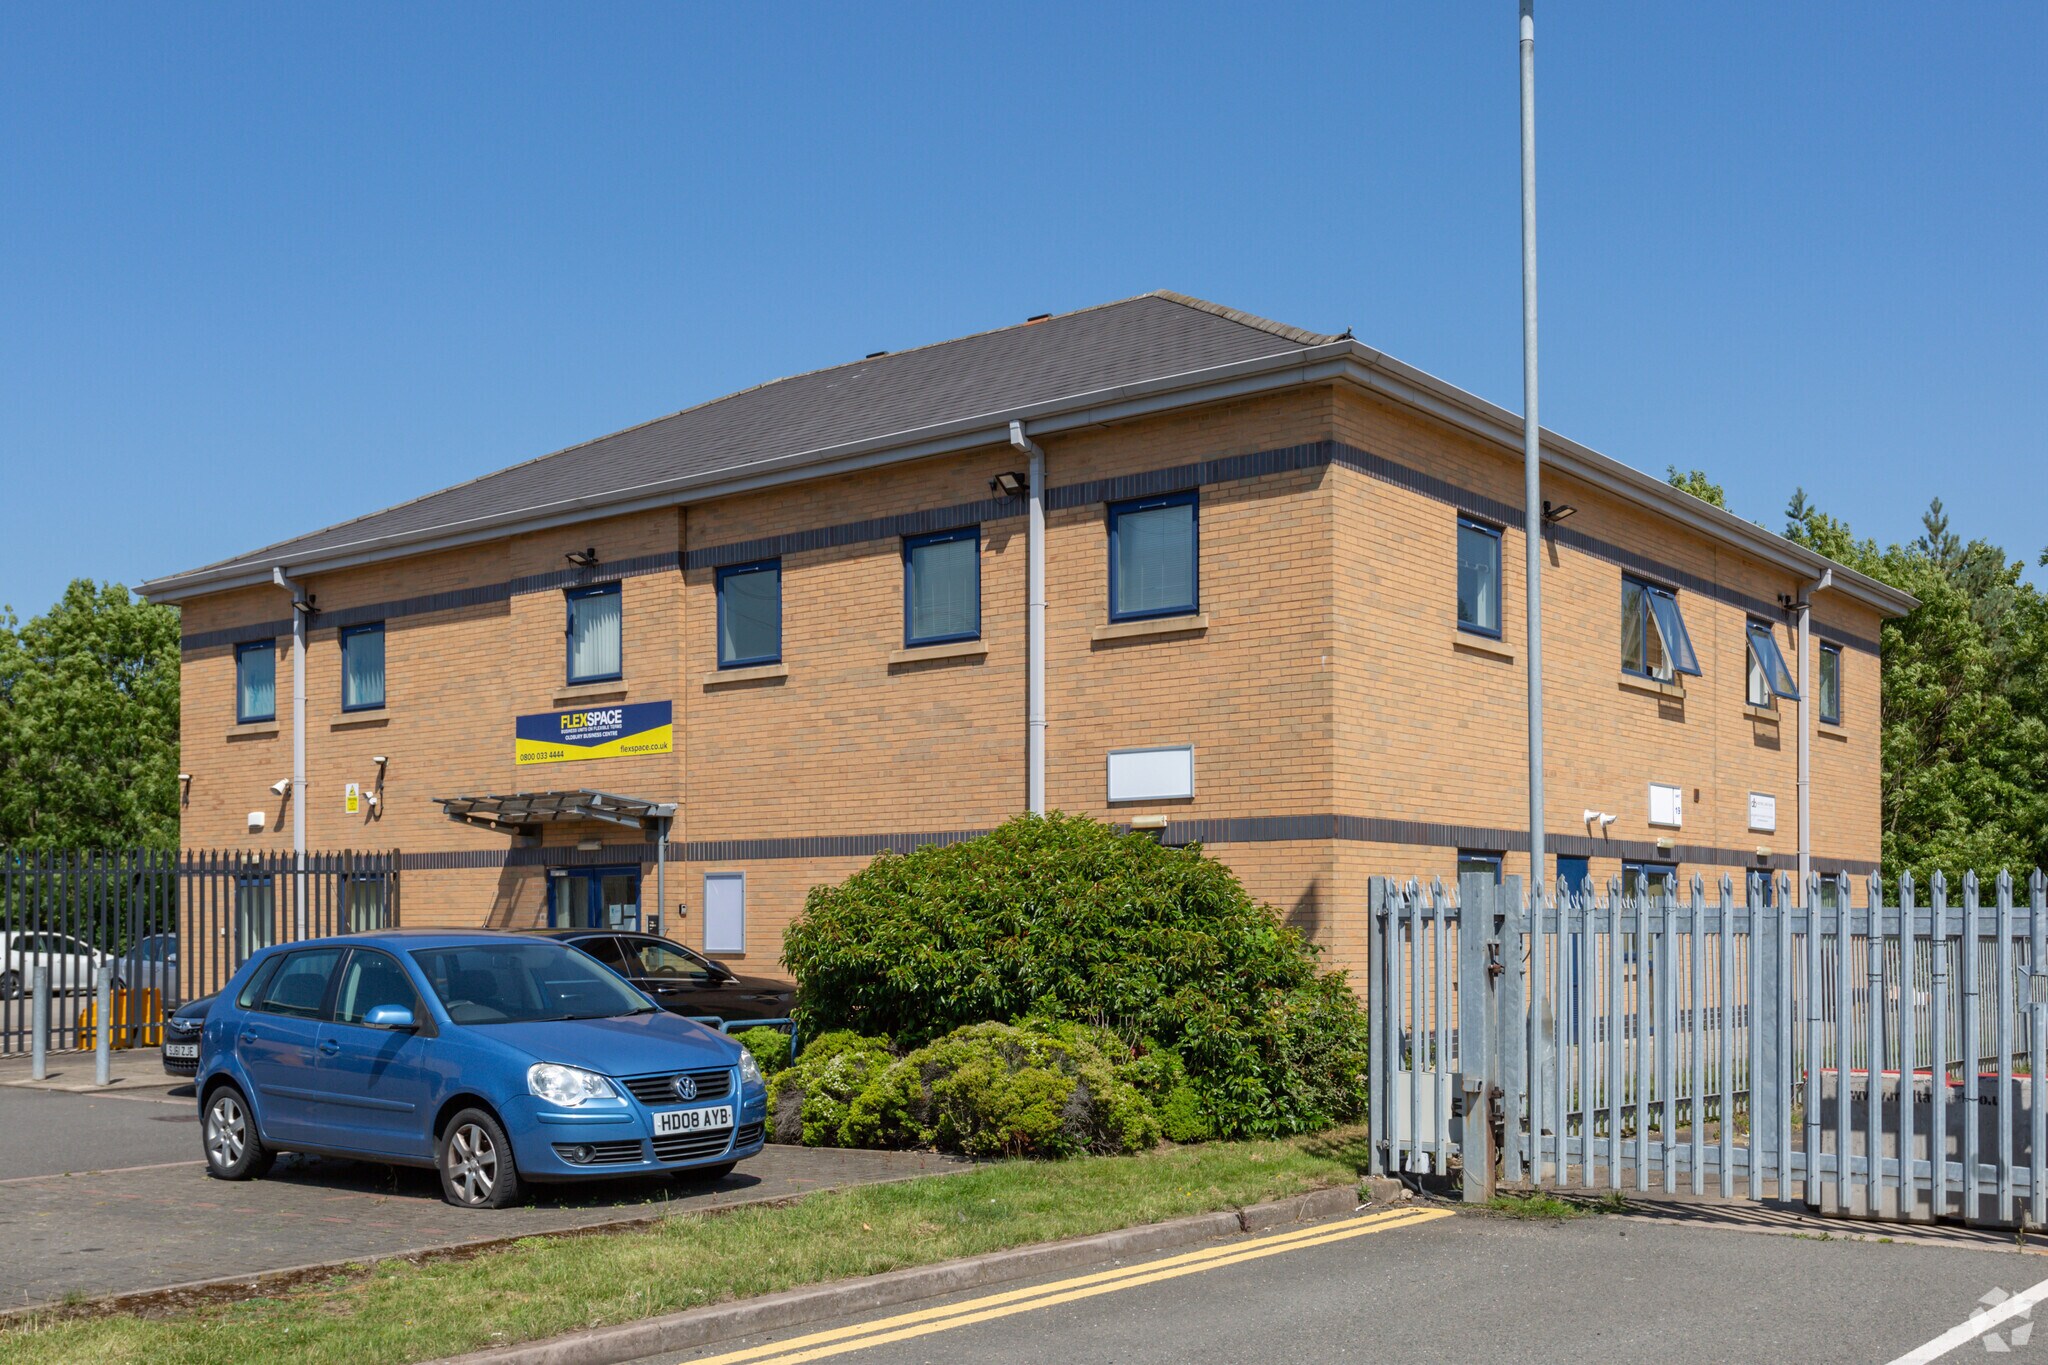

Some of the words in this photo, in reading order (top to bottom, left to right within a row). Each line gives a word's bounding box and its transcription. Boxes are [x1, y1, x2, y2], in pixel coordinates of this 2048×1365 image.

[561, 709, 623, 730] FLEXSPACE
[520, 752, 535, 761] 0800
[536, 751, 548, 760] 033
[548, 750, 564, 759] 4444
[620, 742, 668, 754] flexspace.co.uk
[661, 1112, 700, 1131] HD08
[704, 1108, 728, 1126] AYB
